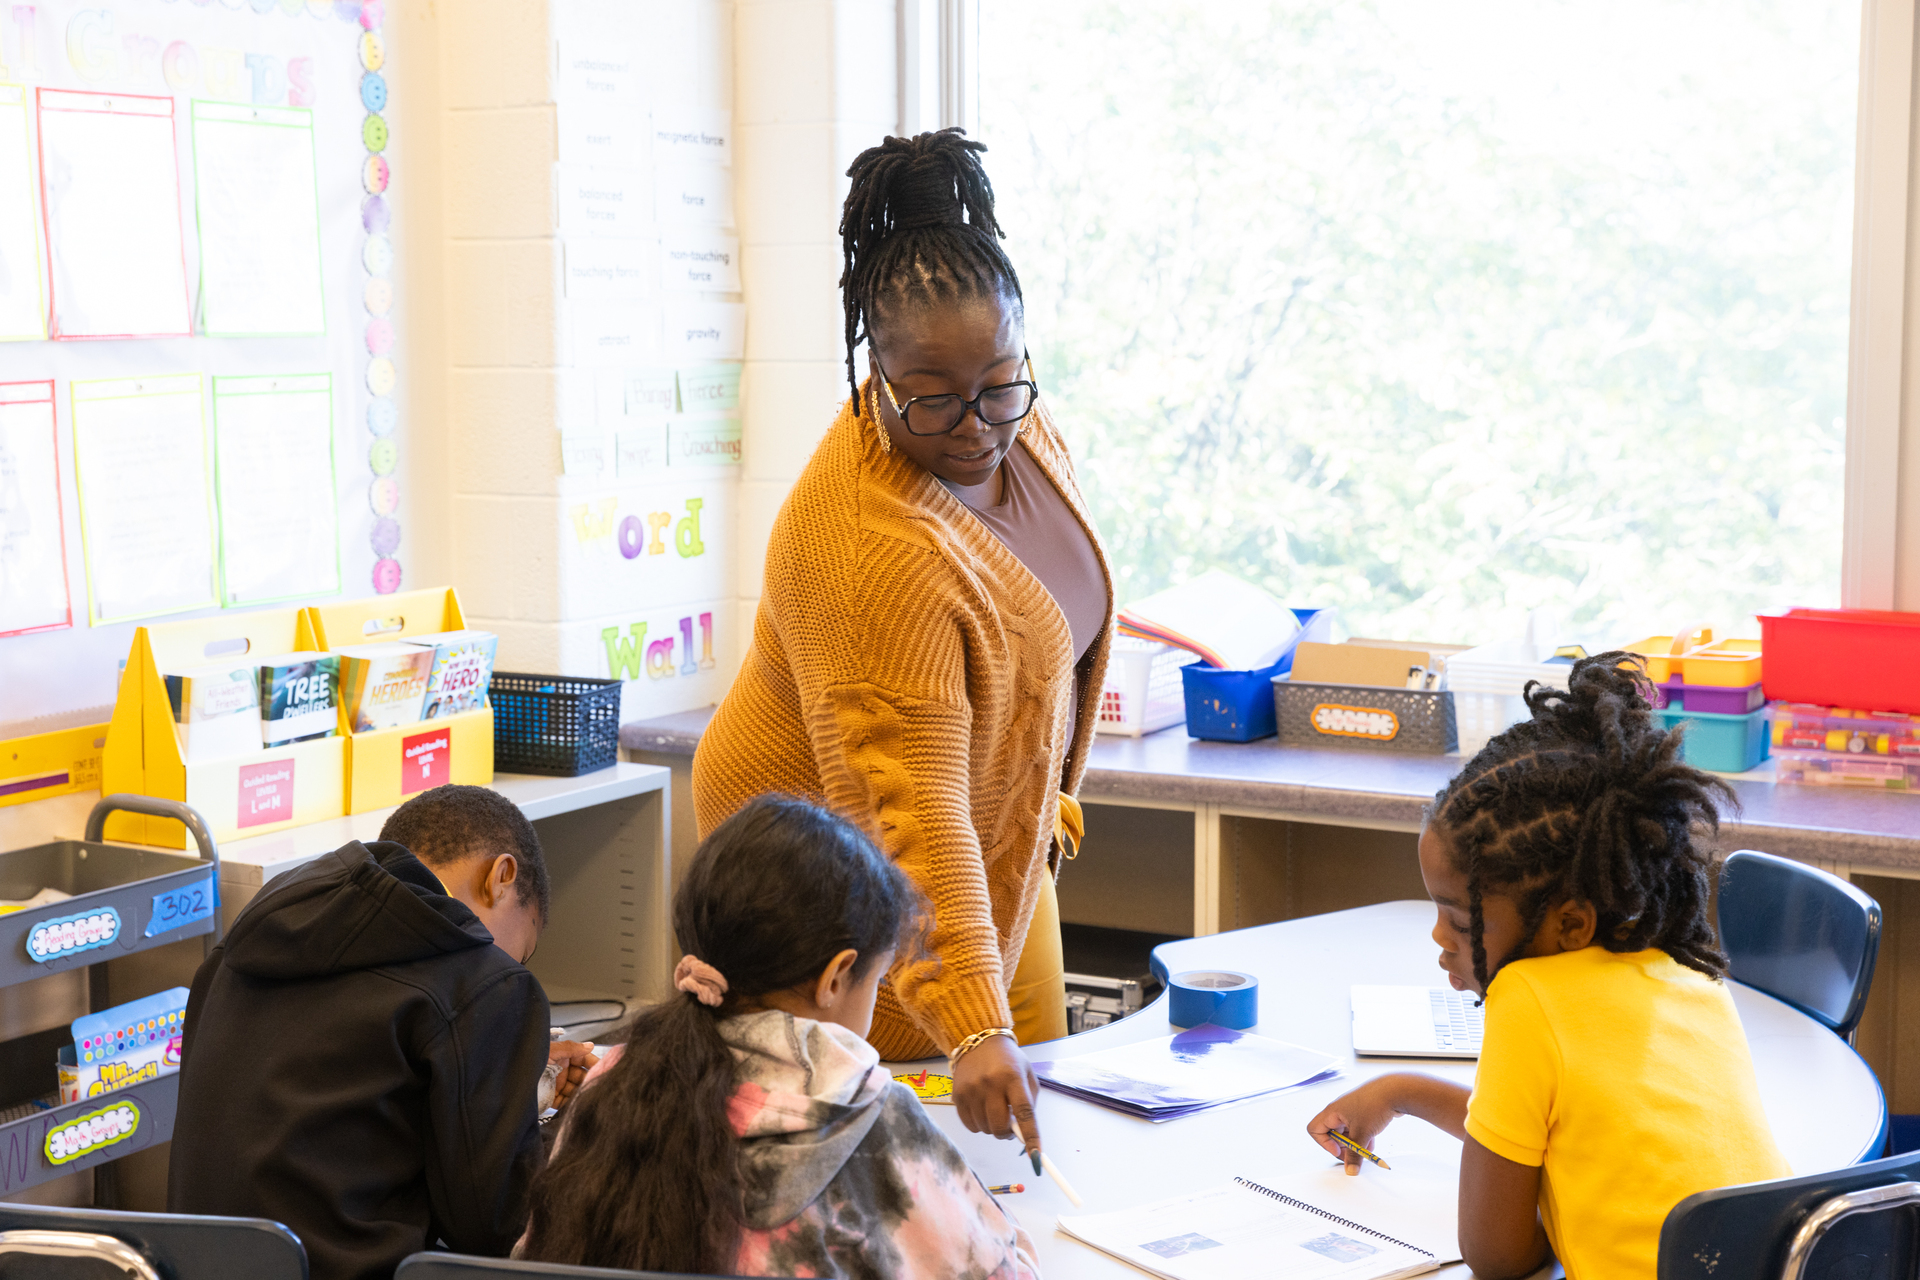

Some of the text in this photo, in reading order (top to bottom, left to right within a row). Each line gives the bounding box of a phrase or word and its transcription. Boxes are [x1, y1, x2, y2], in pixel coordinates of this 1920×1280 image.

[66, 8, 316, 107] Groups
[572, 58, 629, 74] unbalanced
[586, 77, 616, 92] forces
[586, 134, 612, 146] exert
[657, 130, 725, 147] magnetic force
[578, 187, 624, 202] balanced
[682, 192, 705, 207] force
[586, 207, 616, 221] forces
[670, 249, 730, 266] non-touching
[572, 265, 641, 280] touching force
[688, 268, 712, 282] force
[598, 334, 631, 347] attract
[686, 326, 721, 342] gravity
[682, 433, 742, 461] Crouching
[569, 497, 704, 560] Word
[601, 612, 716, 681] Wall
[442, 668, 480, 692] HERO
[285, 673, 330, 705] TREE
[369, 677, 424, 706] HEROES
[215, 698, 242, 710] Friends
[405, 738, 447, 758] Guided Reading
[418, 753, 435, 765] LEVEL
[243, 769, 291, 788] Guided Reading
[256, 785, 277, 797] LEVELS
[251, 800, 258, 814] L
[258, 799, 271, 811] and
[161, 890, 208, 921] 302
[44, 924, 104, 948] Reading Groups
[98, 1061, 134, 1085] MR.
[64, 1122, 120, 1148] Math Groups
